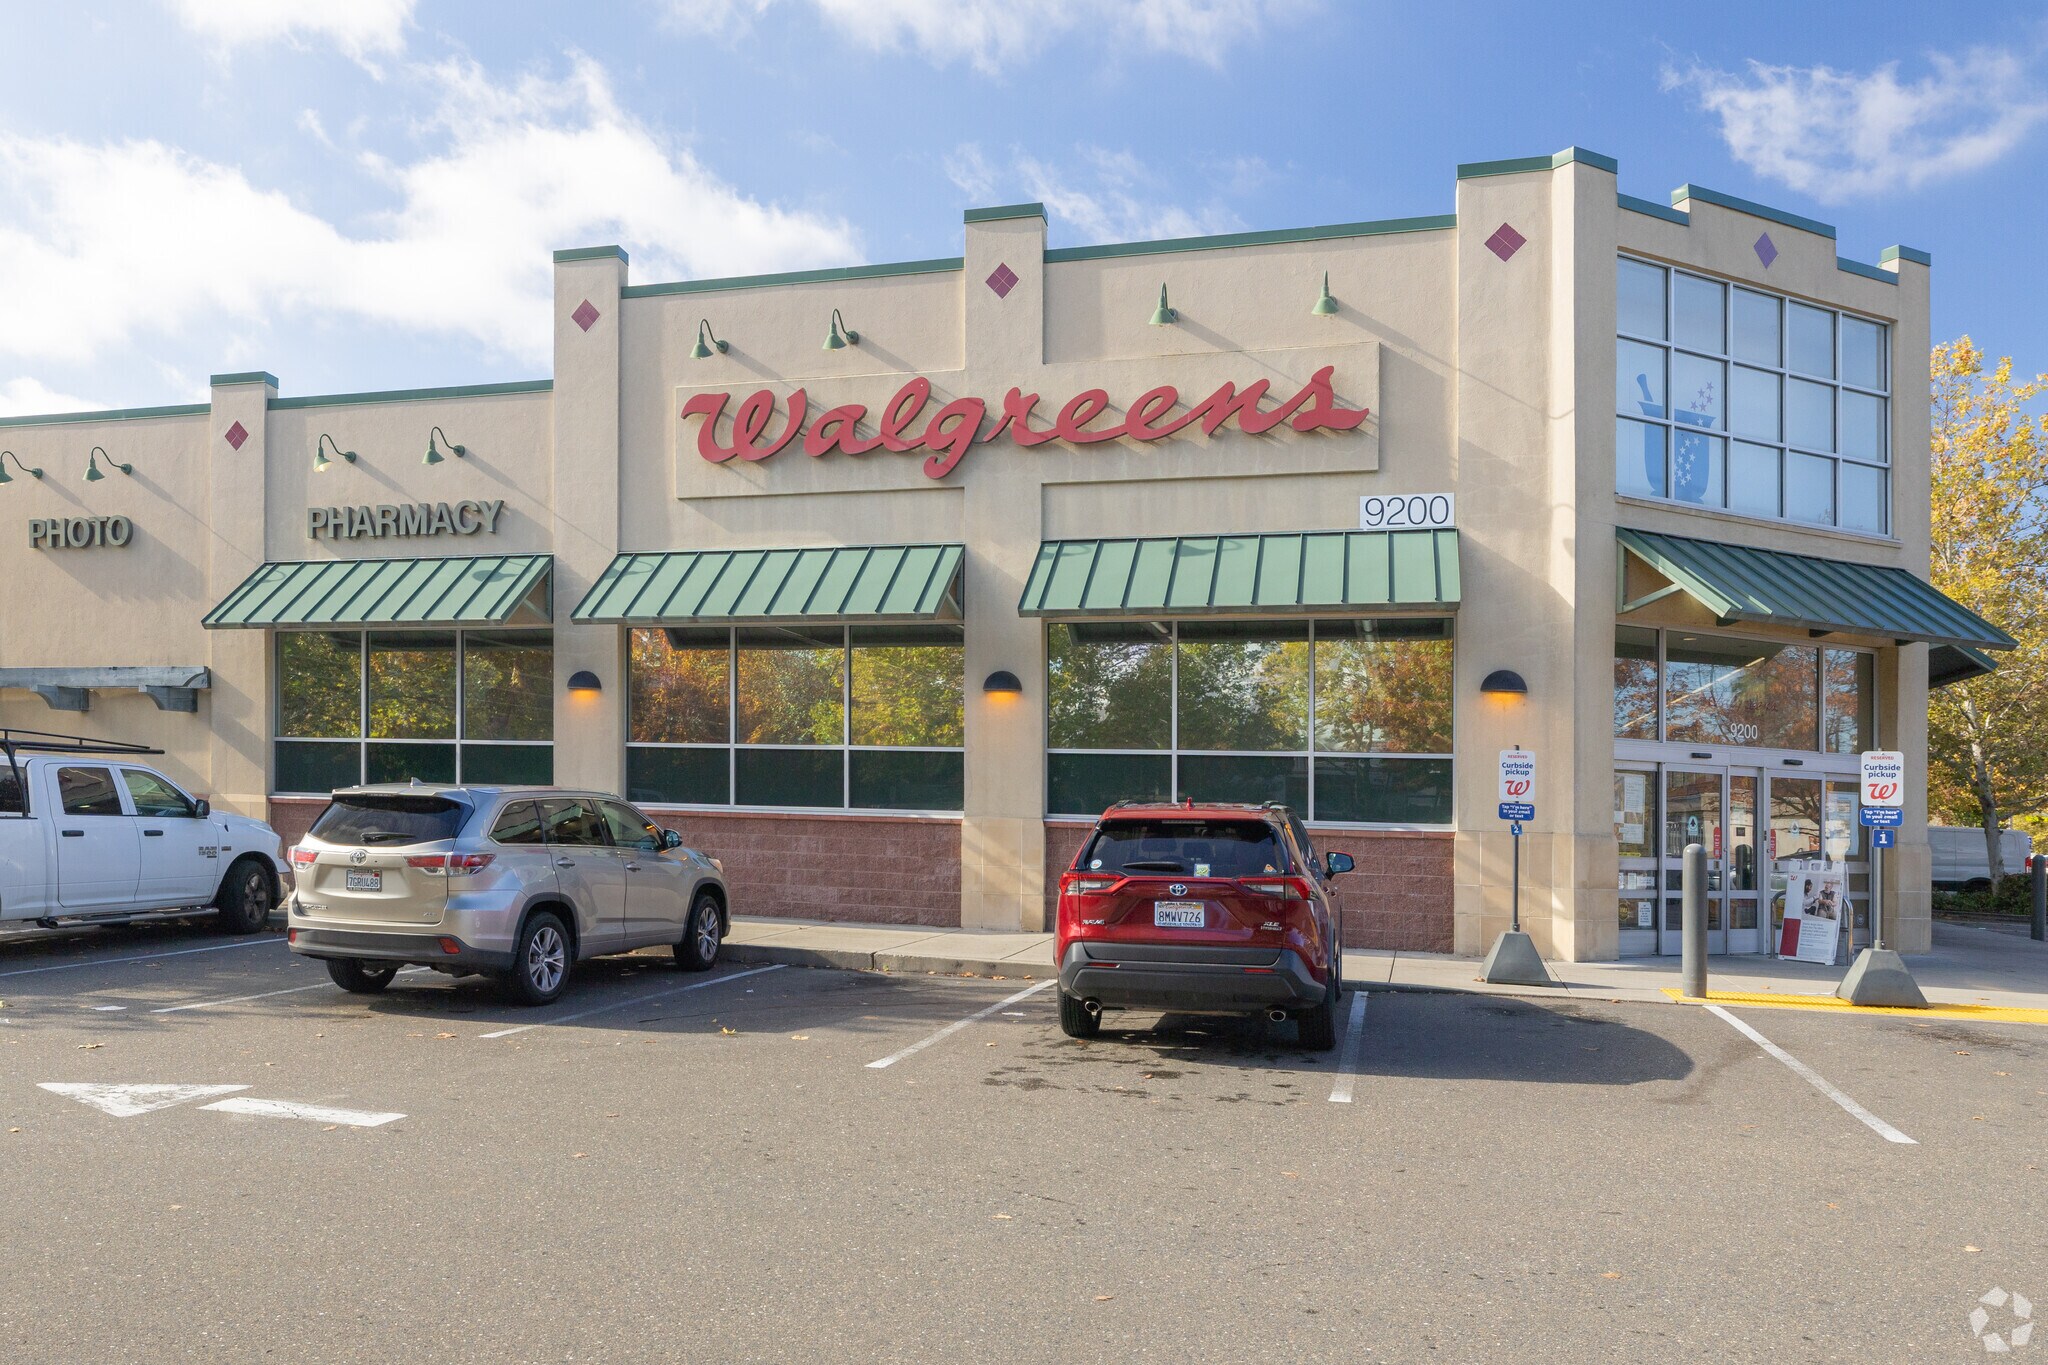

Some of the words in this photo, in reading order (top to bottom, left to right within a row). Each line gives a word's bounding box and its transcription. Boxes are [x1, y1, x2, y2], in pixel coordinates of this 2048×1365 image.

[681, 365, 1369, 480] Walgreens
[306, 499, 504, 539] PHARMACY
[1365, 495, 1449, 526] 9200
[28, 514, 134, 549] PHOTO
[1730, 723, 1758, 739] 9200
[1513, 825, 1520, 834] 2
[1879, 833, 1888, 844] 1
[1158, 911, 1201, 922] 8MWV726
